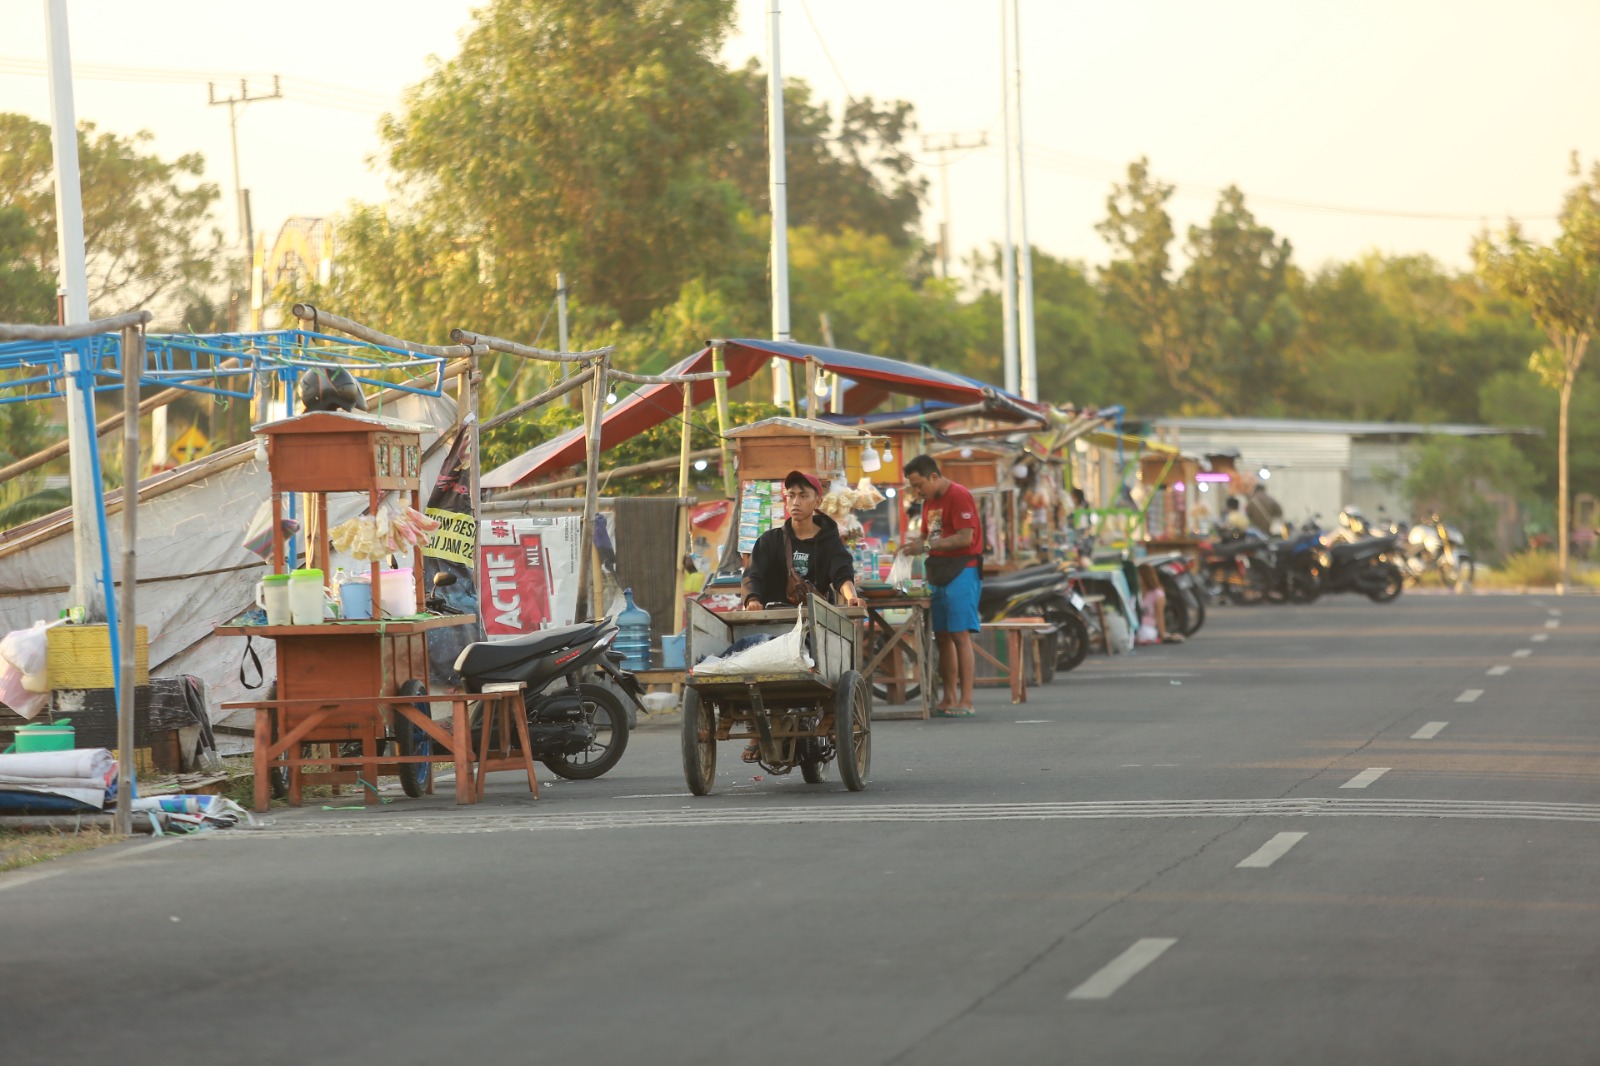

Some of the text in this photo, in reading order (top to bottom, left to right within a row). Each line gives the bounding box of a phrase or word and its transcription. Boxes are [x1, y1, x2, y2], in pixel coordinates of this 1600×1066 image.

[440, 536, 462, 555] JAM
[526, 545, 540, 566] MIL
[486, 551, 524, 630] ACTIF
